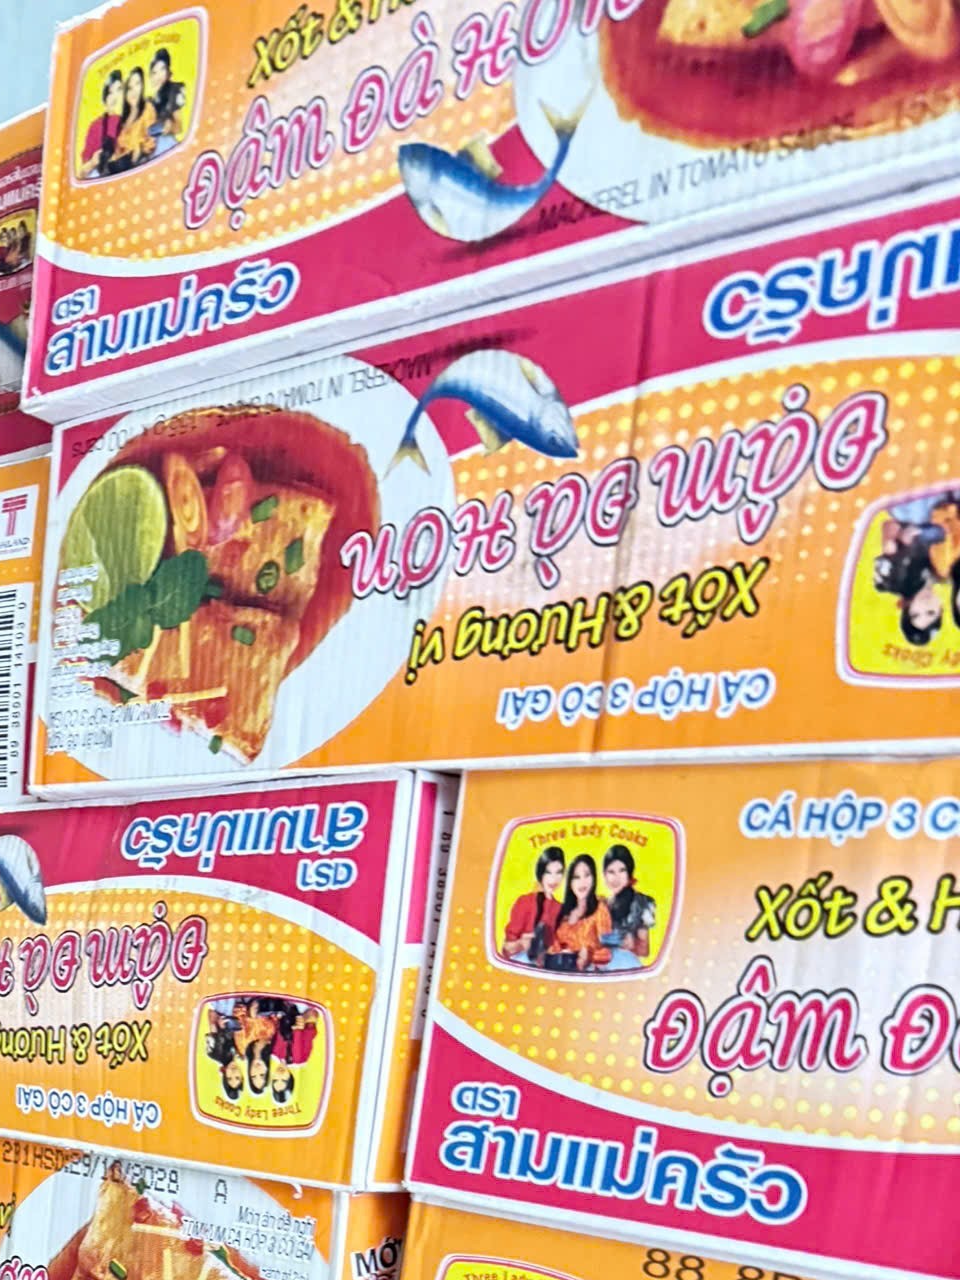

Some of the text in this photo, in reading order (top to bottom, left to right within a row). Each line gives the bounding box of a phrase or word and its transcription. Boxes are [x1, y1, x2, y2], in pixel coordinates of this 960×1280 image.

[247, 3, 324, 87] Xốt
[184, 12, 443, 230] Đậm Đà
[47, 260, 298, 373] สามแม่ครัว
[54, 286, 97, 322] ตรา
[340, 491, 516, 600] Hơn
[405, 557, 771, 685] Xốt & Hương vị
[122, 803, 366, 869] สามแม่ครัว
[529, 821, 649, 848] Three Lady Cooks
[299, 861, 355, 889] ตรา
[745, 871, 917, 942] Xốt &
[70, 1023, 91, 1063] &
[96, 1022, 151, 1069] Xốt
[644, 955, 866, 1097] Đậm
[17, 1085, 160, 1128] CÁ HỘP 3 CÔ GÁI
[455, 1084, 517, 1119] ตรา
[214, 1178, 229, 1205] A
[442, 1123, 805, 1224] สามแม่ครัว
